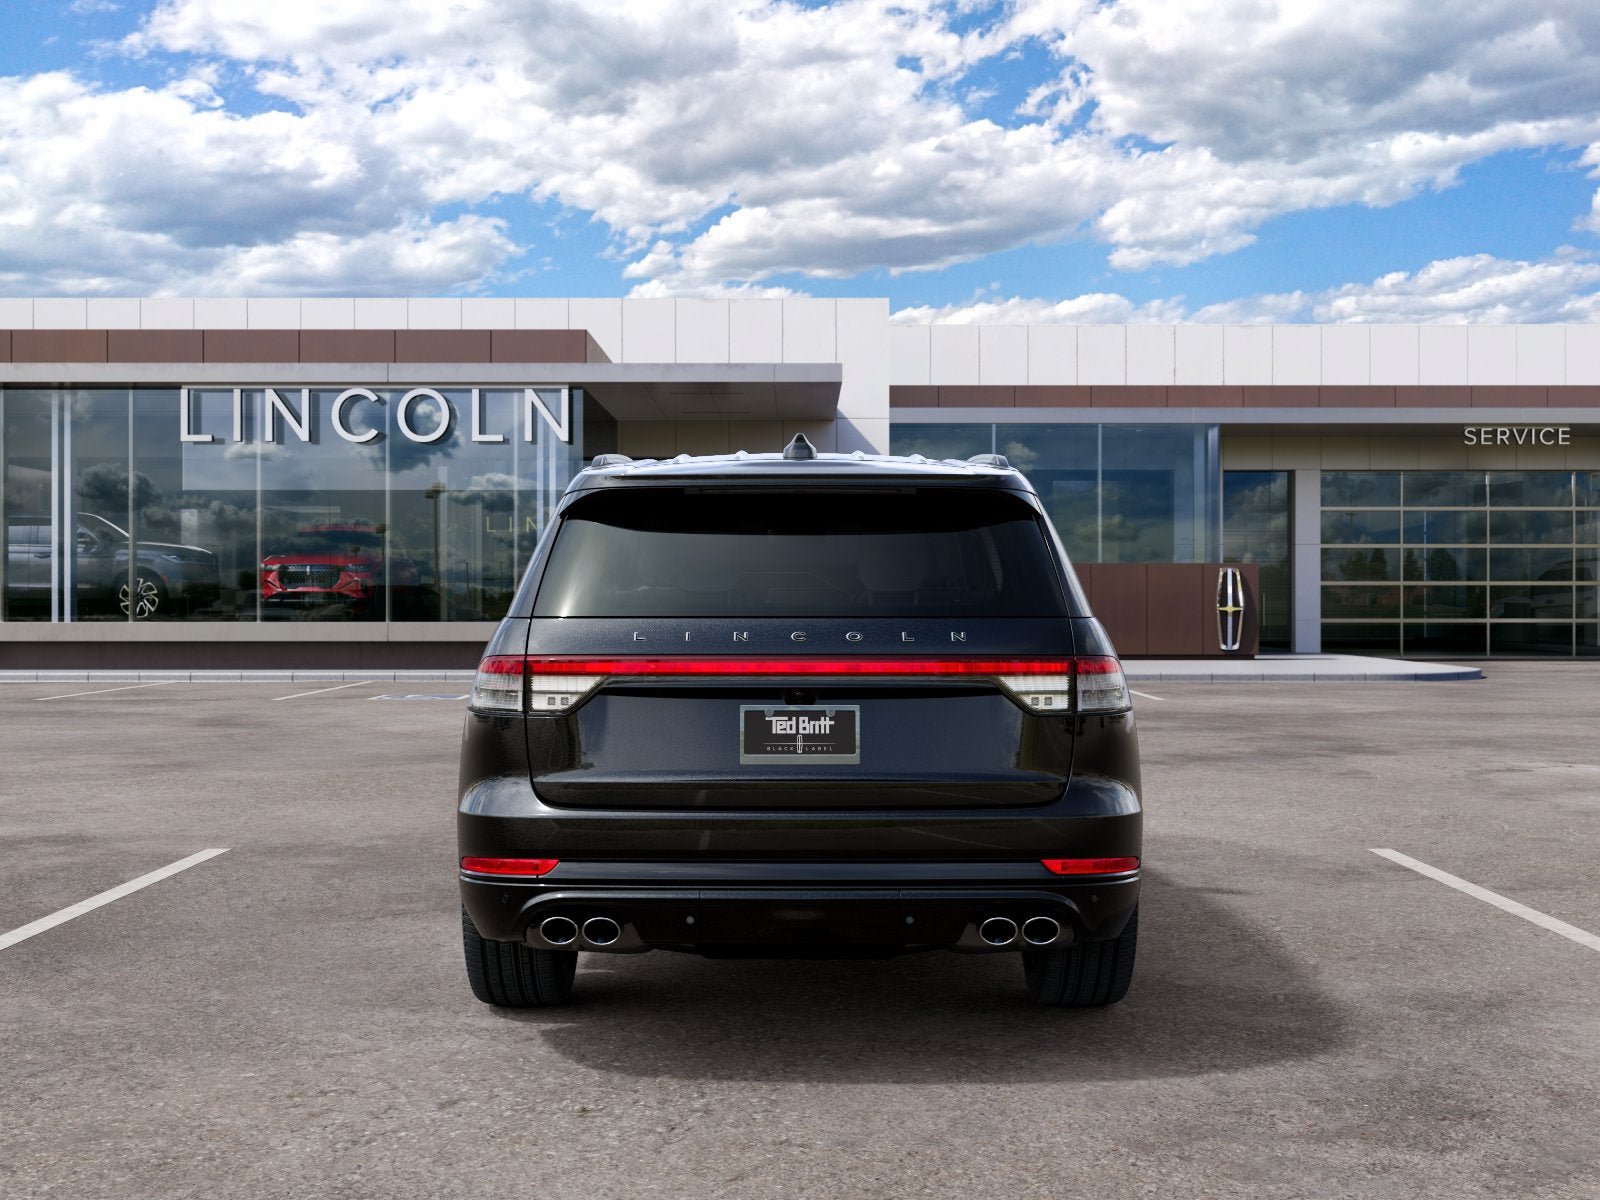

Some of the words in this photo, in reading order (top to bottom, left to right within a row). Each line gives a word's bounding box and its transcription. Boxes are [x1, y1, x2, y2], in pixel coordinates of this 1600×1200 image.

[180, 387, 569, 443] LINCOLN
[1463, 427, 1571, 445] SERVICE
[633, 631, 967, 642] LINCOLN
[765, 716, 796, 734] Ted
[799, 716, 835, 734] Britt
